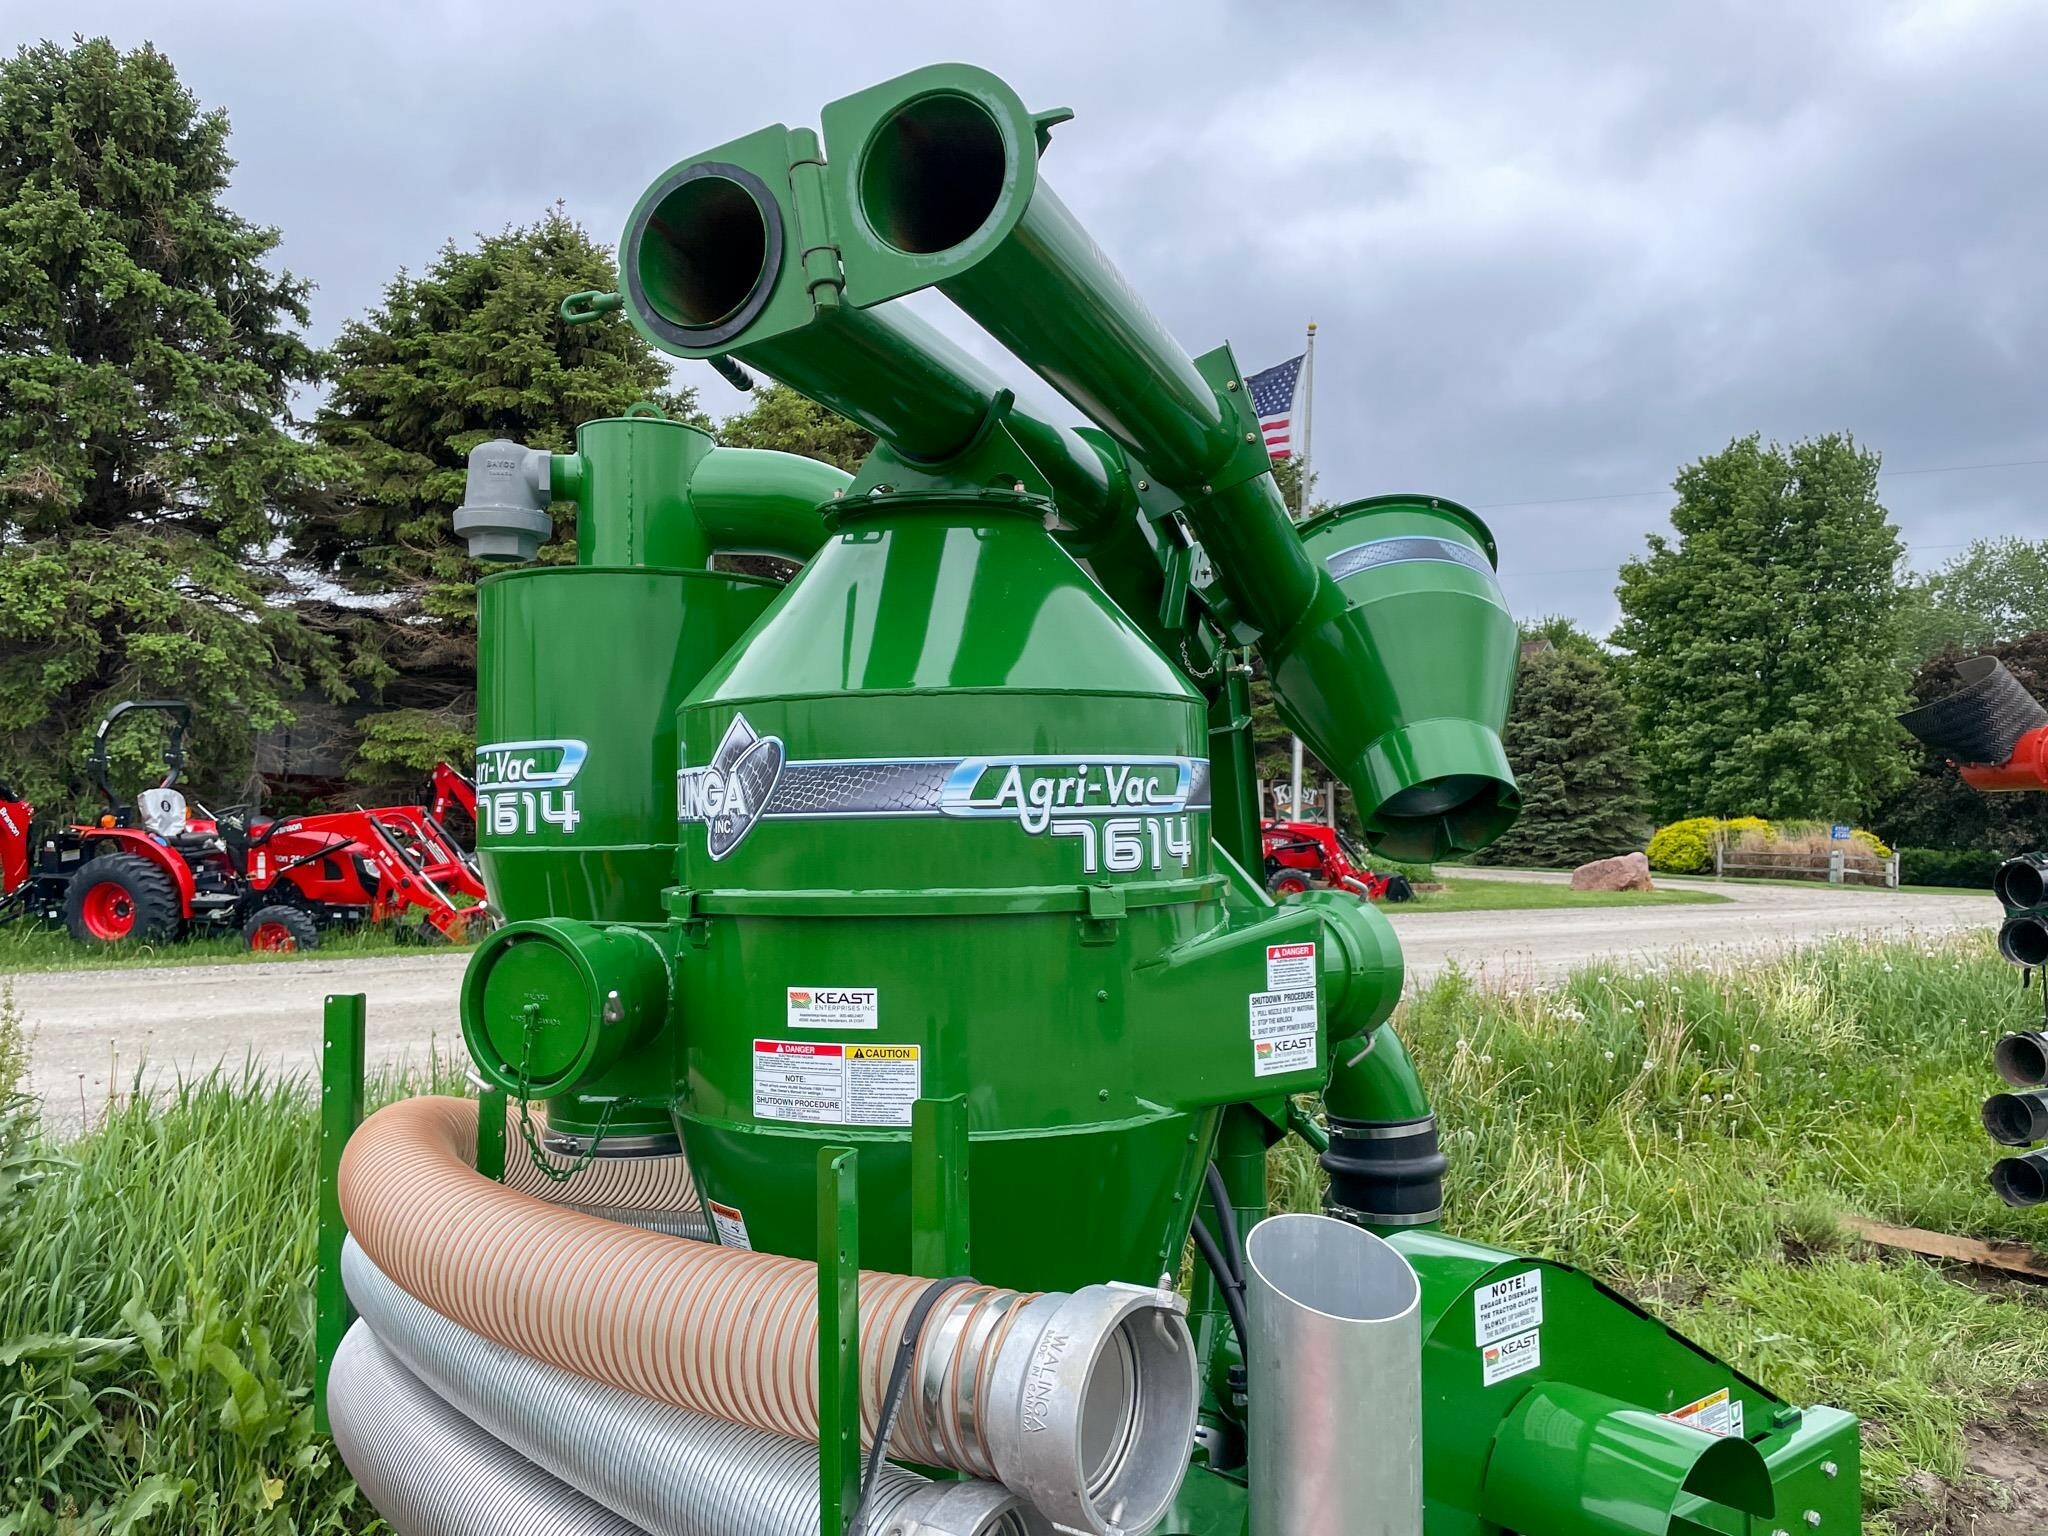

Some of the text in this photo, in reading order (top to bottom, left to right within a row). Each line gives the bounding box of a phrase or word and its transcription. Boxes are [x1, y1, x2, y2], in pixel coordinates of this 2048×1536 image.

[997, 765, 1159, 835] Agri-Vac
[1274, 784, 1317, 805] KST
[479, 791, 580, 835] 7614
[715, 820, 733, 833] INC.
[1051, 817, 1191, 874] 7614
[1282, 946, 1309, 957] DANGER
[815, 992, 874, 1004] KEAST
[1252, 991, 1314, 1005] SHUTDOWN PROCEDURE
[785, 1045, 815, 1054] DANGER
[866, 1049, 910, 1058] CAUTION
[1275, 1037, 1314, 1052] KEAST
[757, 1096, 839, 1109] SHUTDOWN PROCEDURE
[1492, 1276, 1526, 1298] NOTE!
[1480, 1298, 1502, 1310] ENGAGE
[1508, 1286, 1538, 1301] DISENGAGE
[1480, 1296, 1538, 1321] THE TRACTOR CLUTCH
[1501, 1334, 1537, 1356] KEAST
[1023, 1329, 1056, 1432] MADE IN CANADA
[1032, 1335, 1069, 1433] WALINGA
